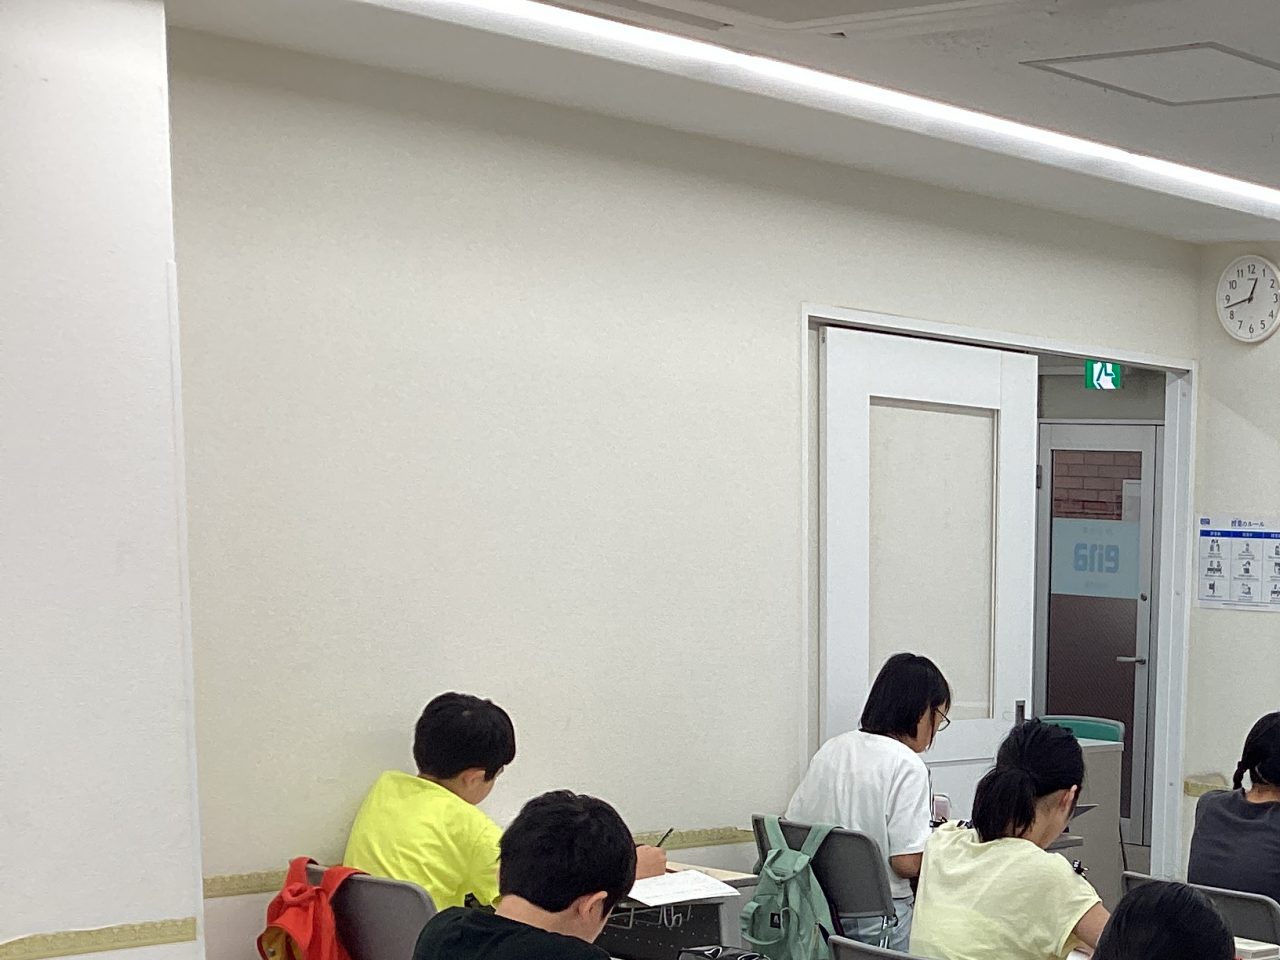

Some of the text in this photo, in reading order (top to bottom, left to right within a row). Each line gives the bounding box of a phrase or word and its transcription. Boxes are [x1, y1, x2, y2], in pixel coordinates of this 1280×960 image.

[1237, 269, 1244, 278] 11
[1247, 264, 1256, 274] 12
[1229, 279, 1237, 290] 10
[1270, 279, 1275, 288] 2
[1225, 294, 1231, 304] 9
[1273, 293, 1279, 303] 3
[1229, 310, 1235, 320] 8
[1268, 309, 1274, 319] 4
[1237, 320, 1243, 330] 7
[1249, 324, 1255, 334] 6
[1260, 320, 1266, 329] 5
